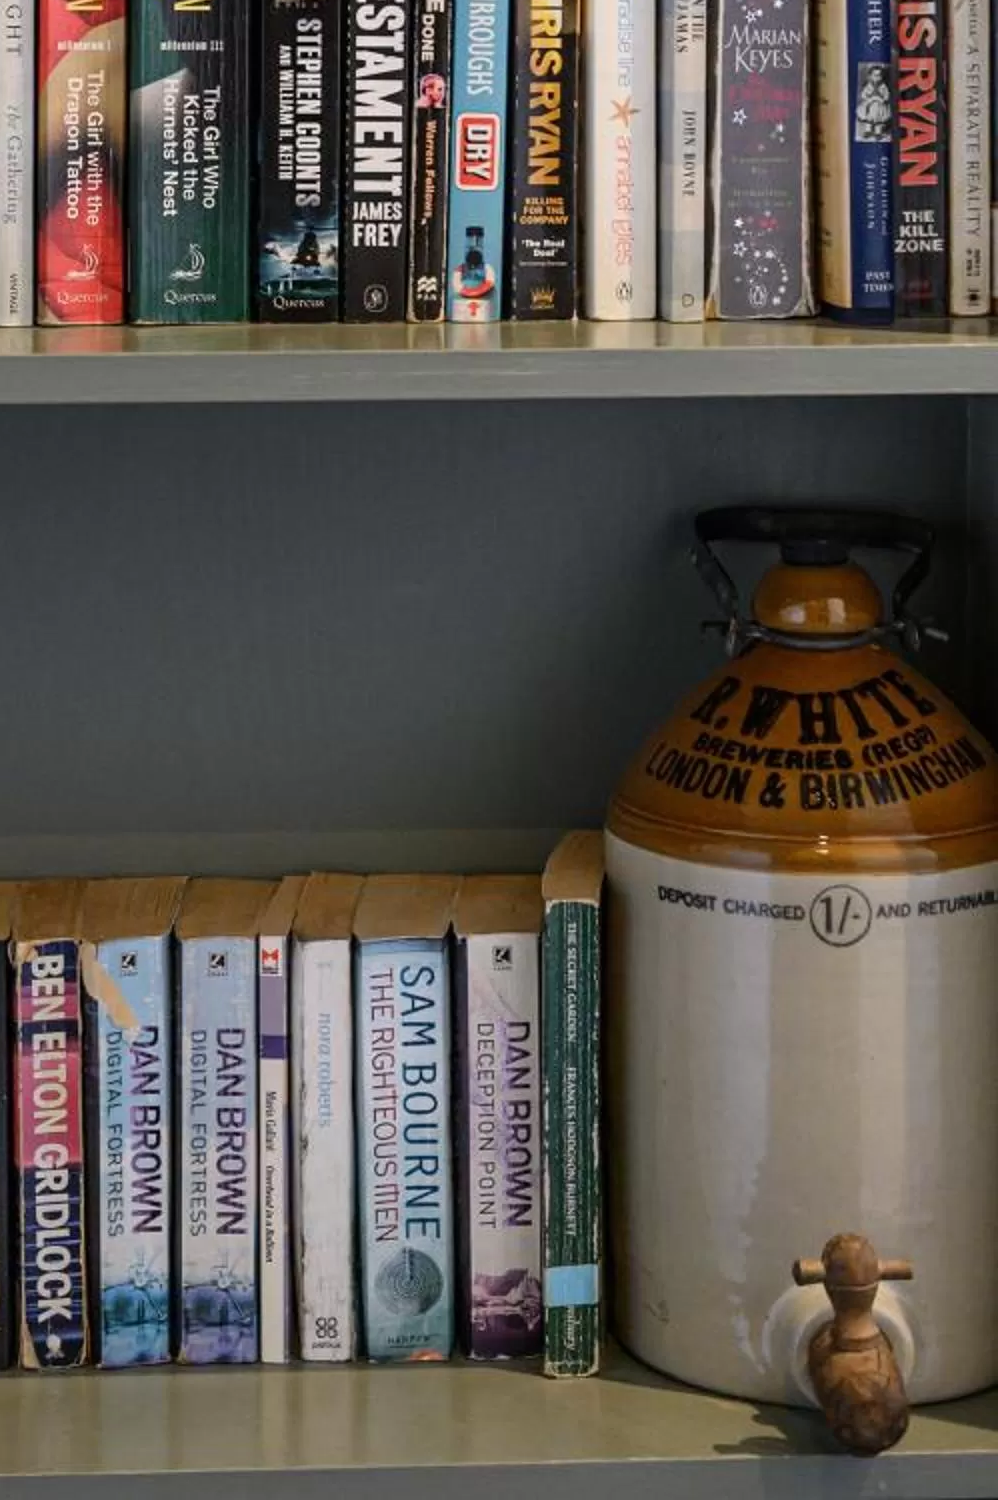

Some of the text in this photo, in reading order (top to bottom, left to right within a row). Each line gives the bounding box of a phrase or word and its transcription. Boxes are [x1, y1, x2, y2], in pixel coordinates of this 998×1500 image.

[62, 77, 83, 221] Dragon Tattoo
[85, 70, 104, 226] The Girl with the
[181, 93, 200, 200] Kicked the
[202, 84, 221, 209] The Girl Who
[296, 19, 322, 207] STEPHEN COONTS
[465, 123, 493, 181] DRY
[525, 82, 563, 186] RYAN
[896, 57, 938, 187] RYAN
[353, 200, 403, 223] JAMES
[353, 223, 403, 248] FREY
[894, 239, 944, 253] ZONE
[899, 224, 939, 238] KILL
[902, 210, 935, 223] THE
[690, 668, 938, 745] R. WHITE
[692, 731, 855, 771] BREWERIES
[644, 734, 987, 810] LONDON & BIRMINGHAM
[657, 884, 717, 913] DEPOSIT
[722, 898, 805, 922] CHARGED
[875, 902, 912, 918] AND
[31, 955, 72, 1323] BEN ELTON GRIDLOCK
[105, 1029, 125, 1237] DIGITAL FORTRESS
[189, 1029, 208, 1237] DIGITAL FORTRESS
[215, 1028, 247, 1235] DAN BROWN
[399, 965, 441, 1241] SAM BOURNE
[477, 1023, 496, 1230] DECEPTION POINT
[504, 1020, 533, 1227] DAN BROWN
